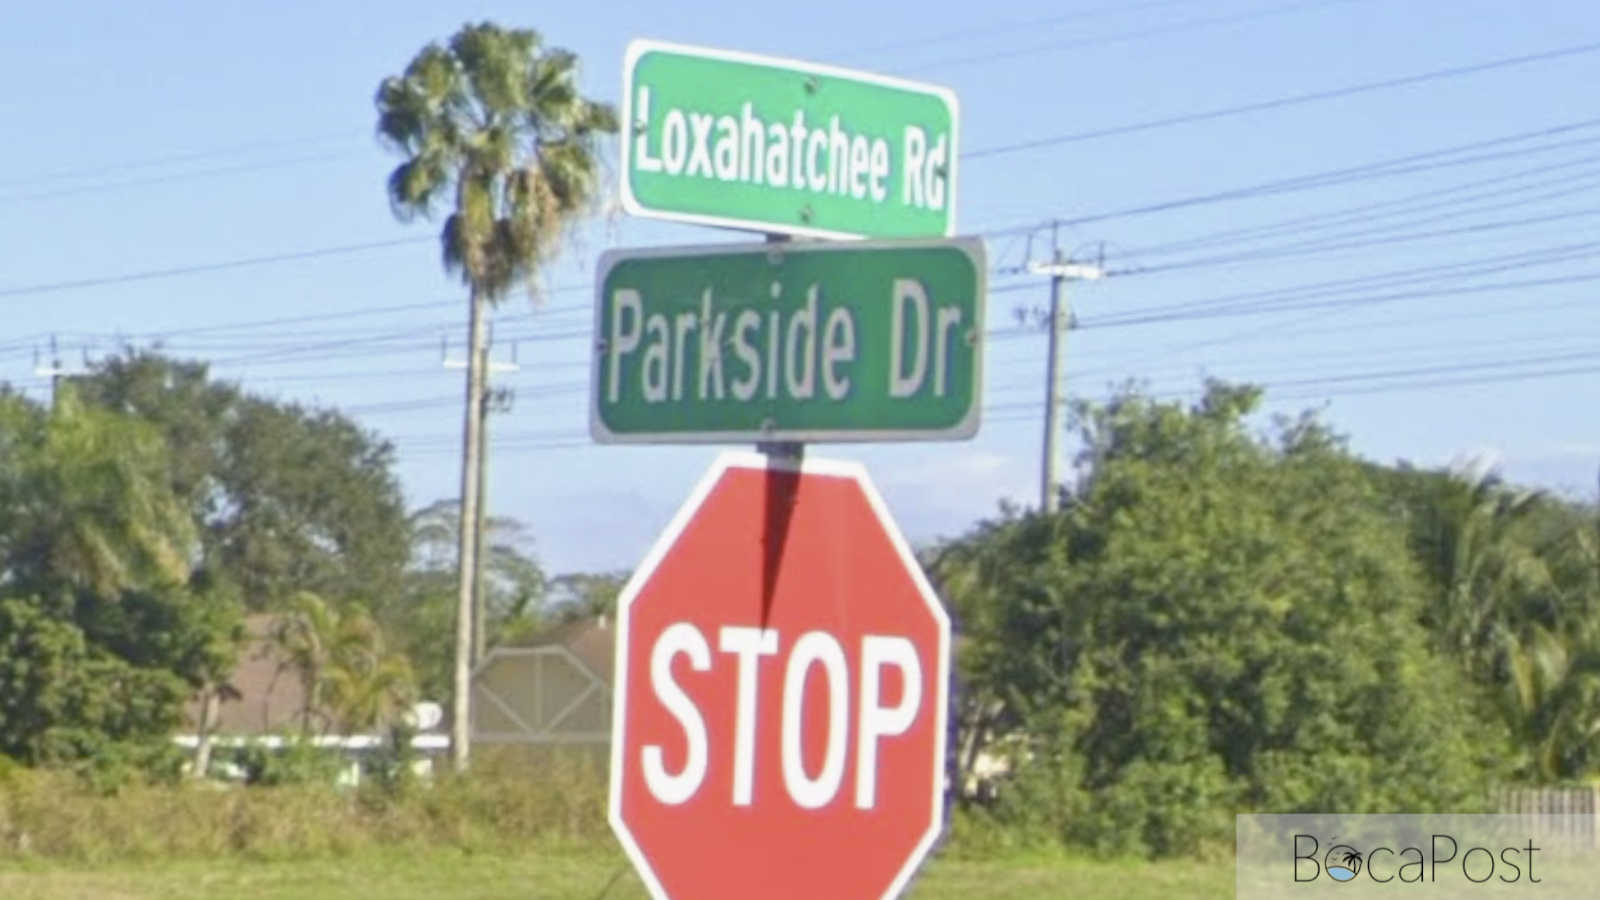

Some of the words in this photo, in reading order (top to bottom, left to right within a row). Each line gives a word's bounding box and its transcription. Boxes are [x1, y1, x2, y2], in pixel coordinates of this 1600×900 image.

[635, 85, 889, 202] Loxahatchee
[903, 125, 947, 211] Rd
[608, 281, 856, 403] Parkside
[889, 278, 962, 399] Dr
[641, 621, 923, 810] STOP
